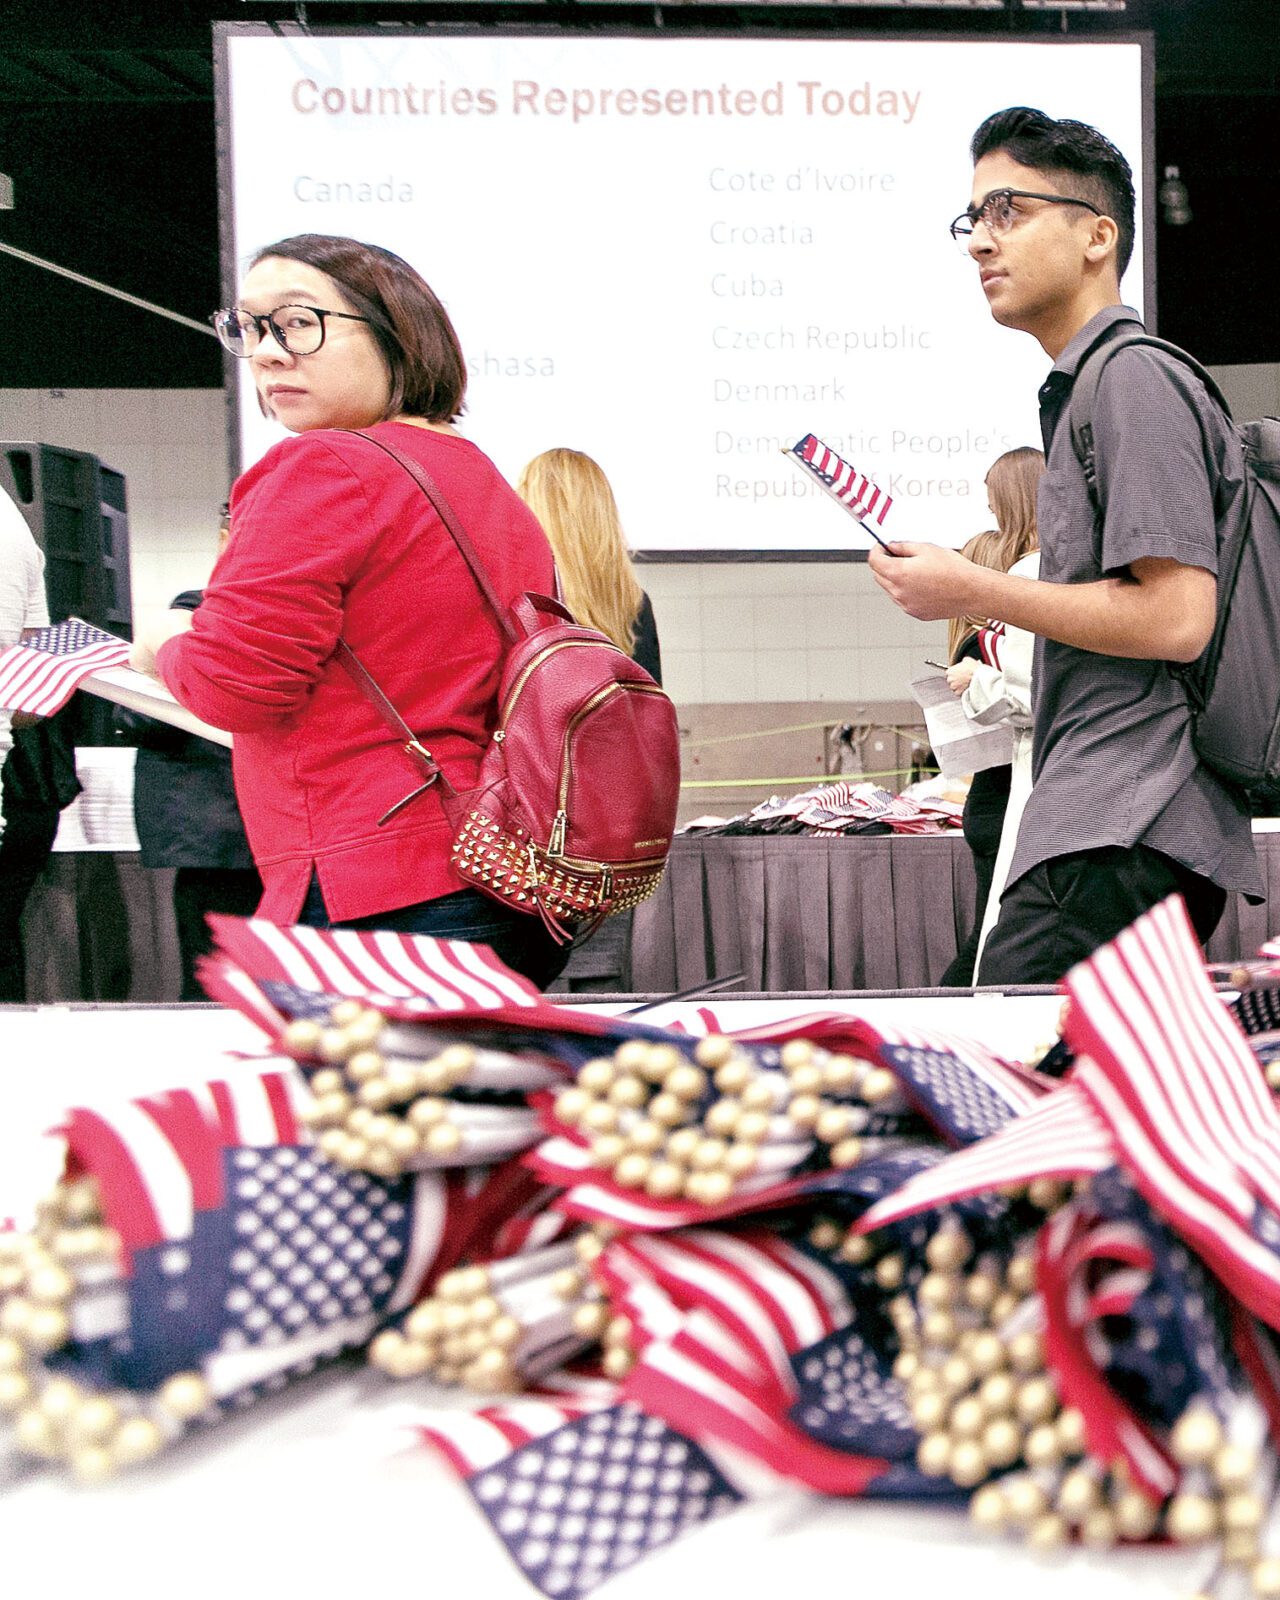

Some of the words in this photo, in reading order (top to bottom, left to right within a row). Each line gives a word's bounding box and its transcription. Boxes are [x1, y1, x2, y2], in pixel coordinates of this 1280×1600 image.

[291, 77, 499, 116] Countries
[511, 79, 784, 124] Represented
[796, 80, 922, 124] Today
[293, 174, 415, 203] Canada
[708, 166, 775, 192] Cote
[709, 219, 815, 245] Croatia
[710, 271, 785, 298] Cuba
[711, 324, 796, 350] Czech
[806, 323, 932, 354] Republic
[468, 348, 555, 377] shasa
[713, 375, 847, 402] Denmark
[891, 427, 1012, 459] People's
[889, 474, 970, 497] Korea
